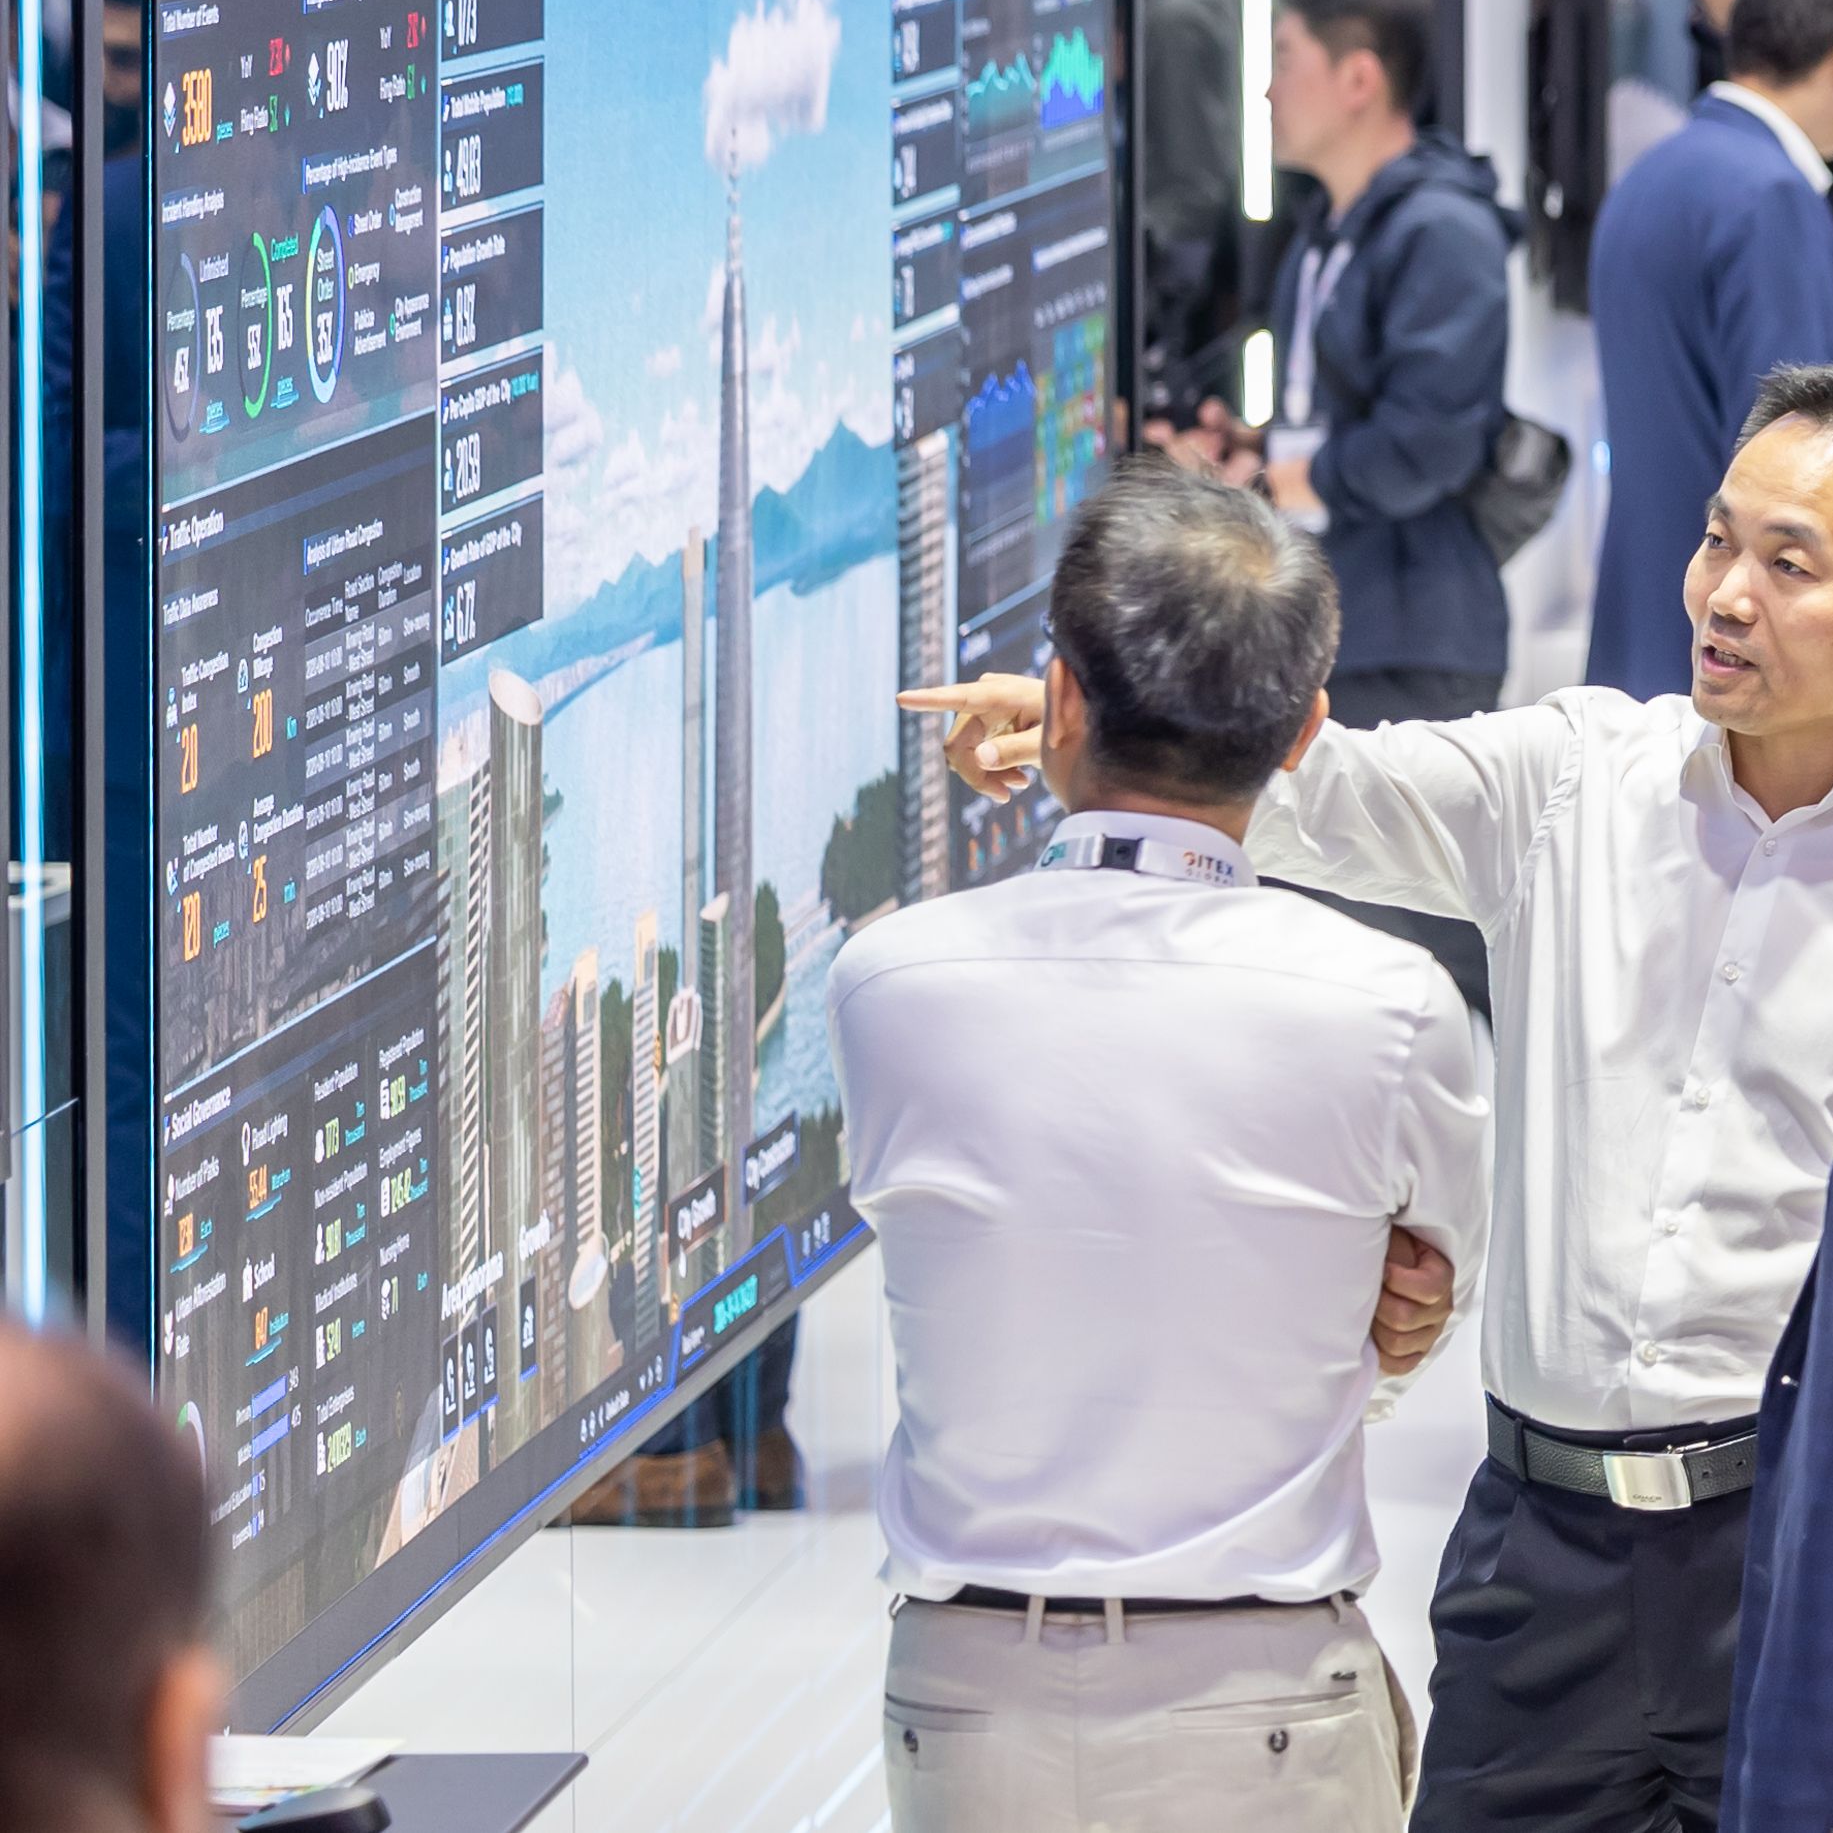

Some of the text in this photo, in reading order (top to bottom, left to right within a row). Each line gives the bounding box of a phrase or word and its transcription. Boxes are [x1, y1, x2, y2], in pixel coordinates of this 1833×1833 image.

[326, 43, 348, 108] 90%
[182, 72, 211, 142] 3580
[270, 234, 298, 262] Completed
[167, 308, 195, 334] Percentage
[241, 285, 267, 311] Percentage
[169, 508, 223, 550] Traffic Operation
[253, 692, 271, 754] 200
[1183, 851, 1235, 878] GITEX
[252, 858, 266, 920] 25
[183, 894, 200, 959] 120
[172, 1085, 230, 1137] Social Governance
[254, 1255, 274, 1287] School
